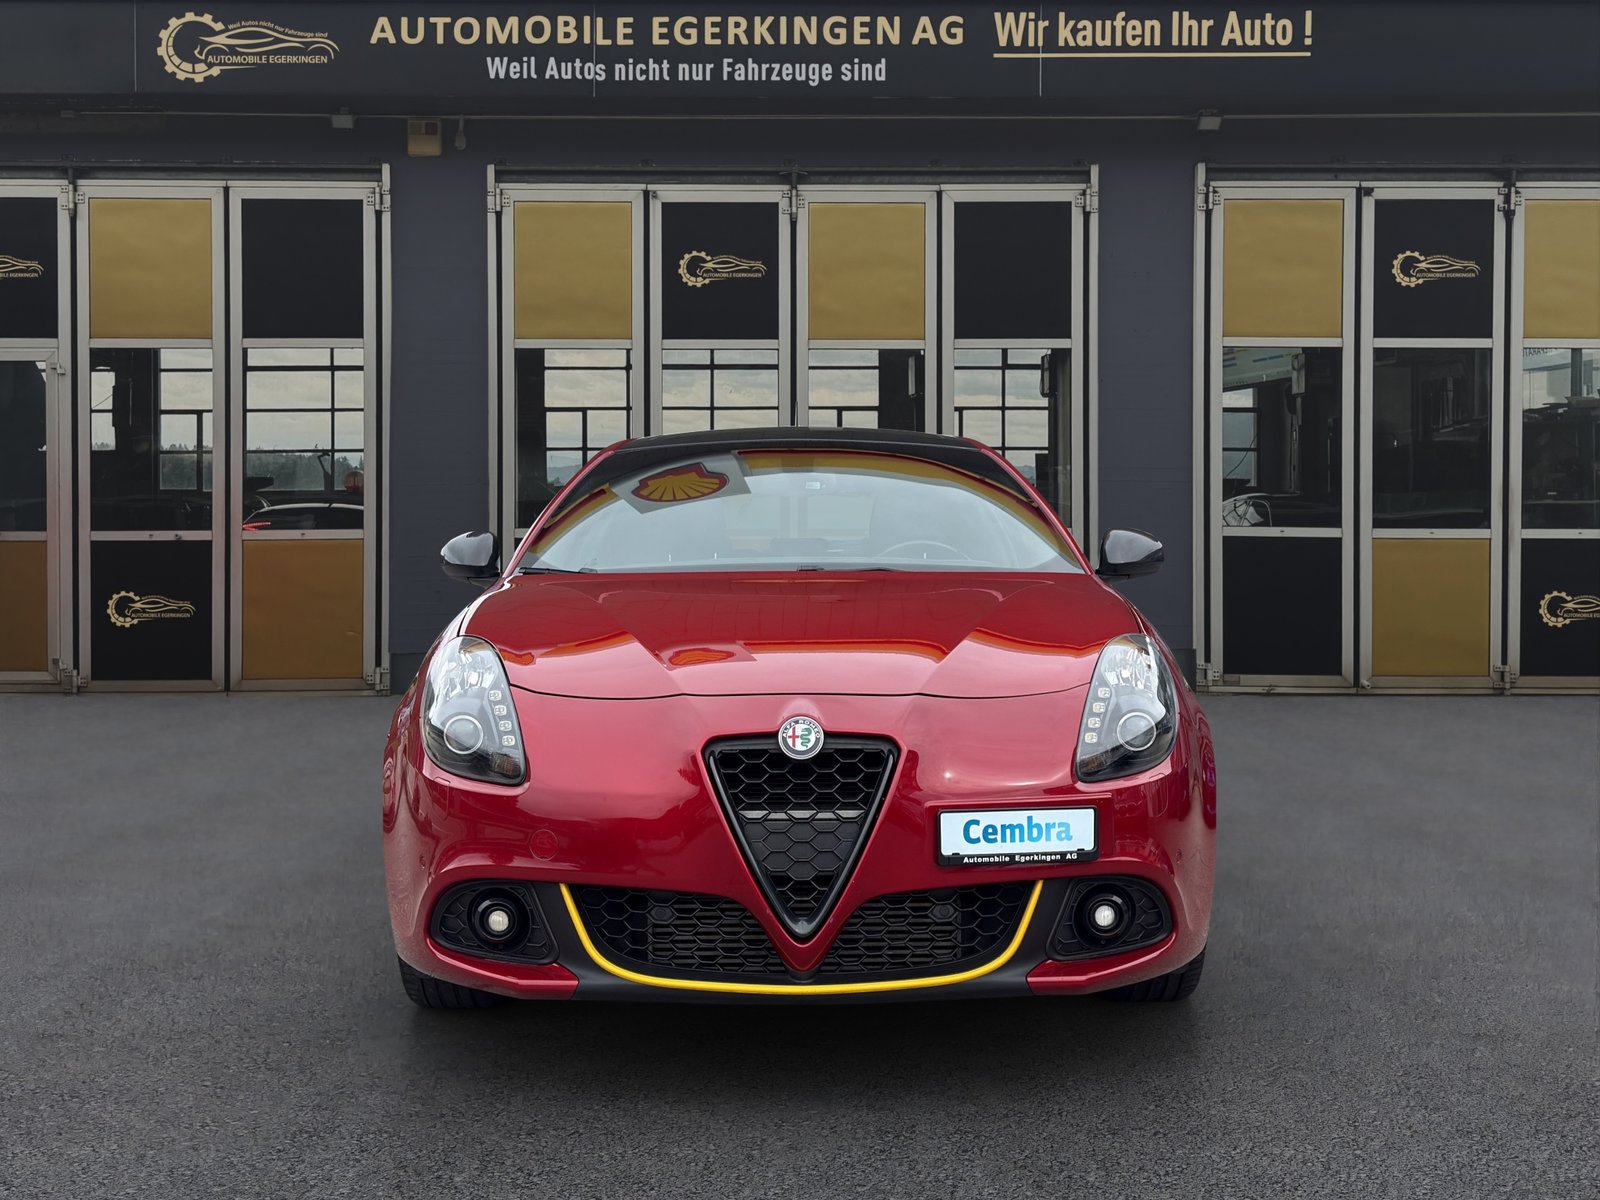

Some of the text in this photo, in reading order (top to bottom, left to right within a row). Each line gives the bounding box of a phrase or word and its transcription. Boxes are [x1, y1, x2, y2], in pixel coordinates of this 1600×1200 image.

[228, 22, 241, 30] Weil
[259, 20, 275, 29] nicht
[274, 25, 285, 33] nur
[285, 28, 315, 38] Fahrzeuge
[370, 15, 965, 46] AUTOMOBILE EGERKINGEN AG
[994, 9, 1313, 47] Wir kaufen Ihr Auto !
[207, 55, 328, 64] AUTOMOBILE EGERKINGEN
[486, 57, 886, 87] Weil Autos nicht nur Fahrzeuge sind
[782, 719, 821, 739] ALFA ROMEO
[963, 816, 1073, 844] Cembra
[1015, 854, 1061, 862] Egerkingen
